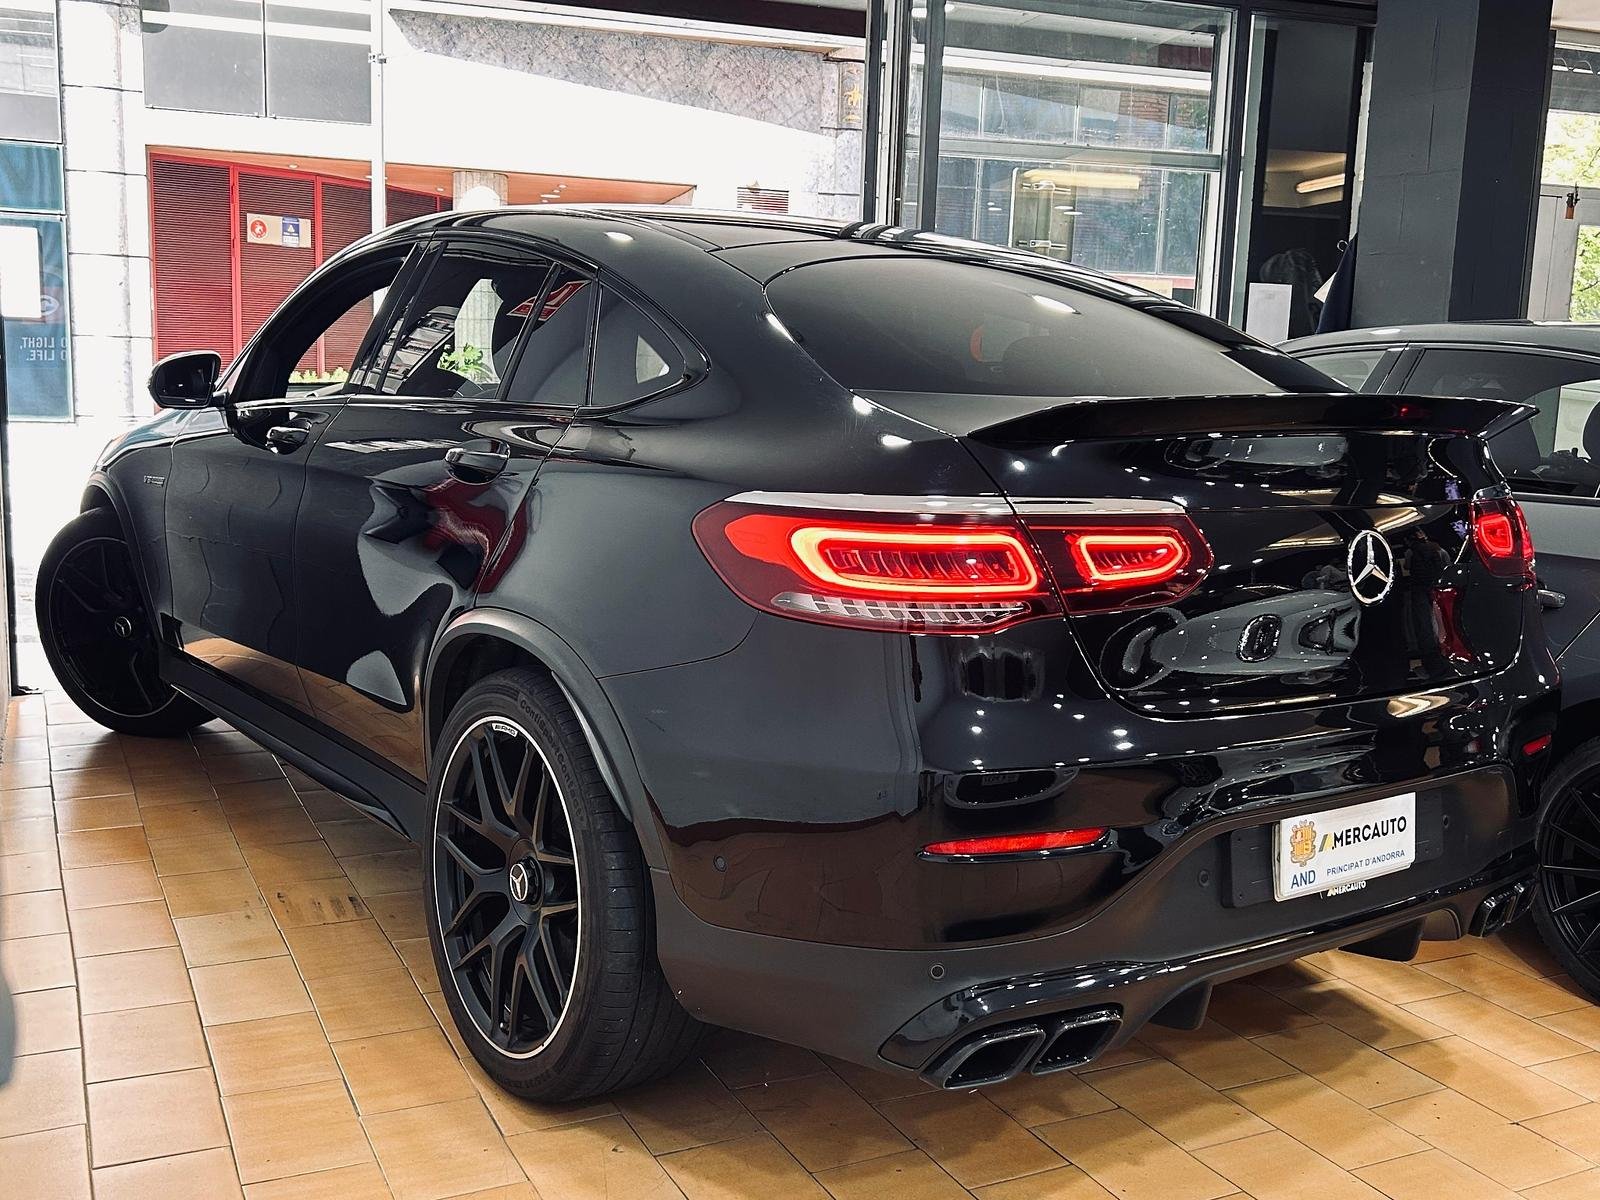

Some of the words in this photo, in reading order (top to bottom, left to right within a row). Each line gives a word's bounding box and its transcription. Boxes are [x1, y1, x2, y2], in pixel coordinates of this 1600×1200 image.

[1331, 815, 1407, 850] MERCAUTO
[1326, 859, 1364, 876] PRINCIPAT
[1365, 849, 1406, 867] D'ANDORRA
[1290, 869, 1316, 889] AND
